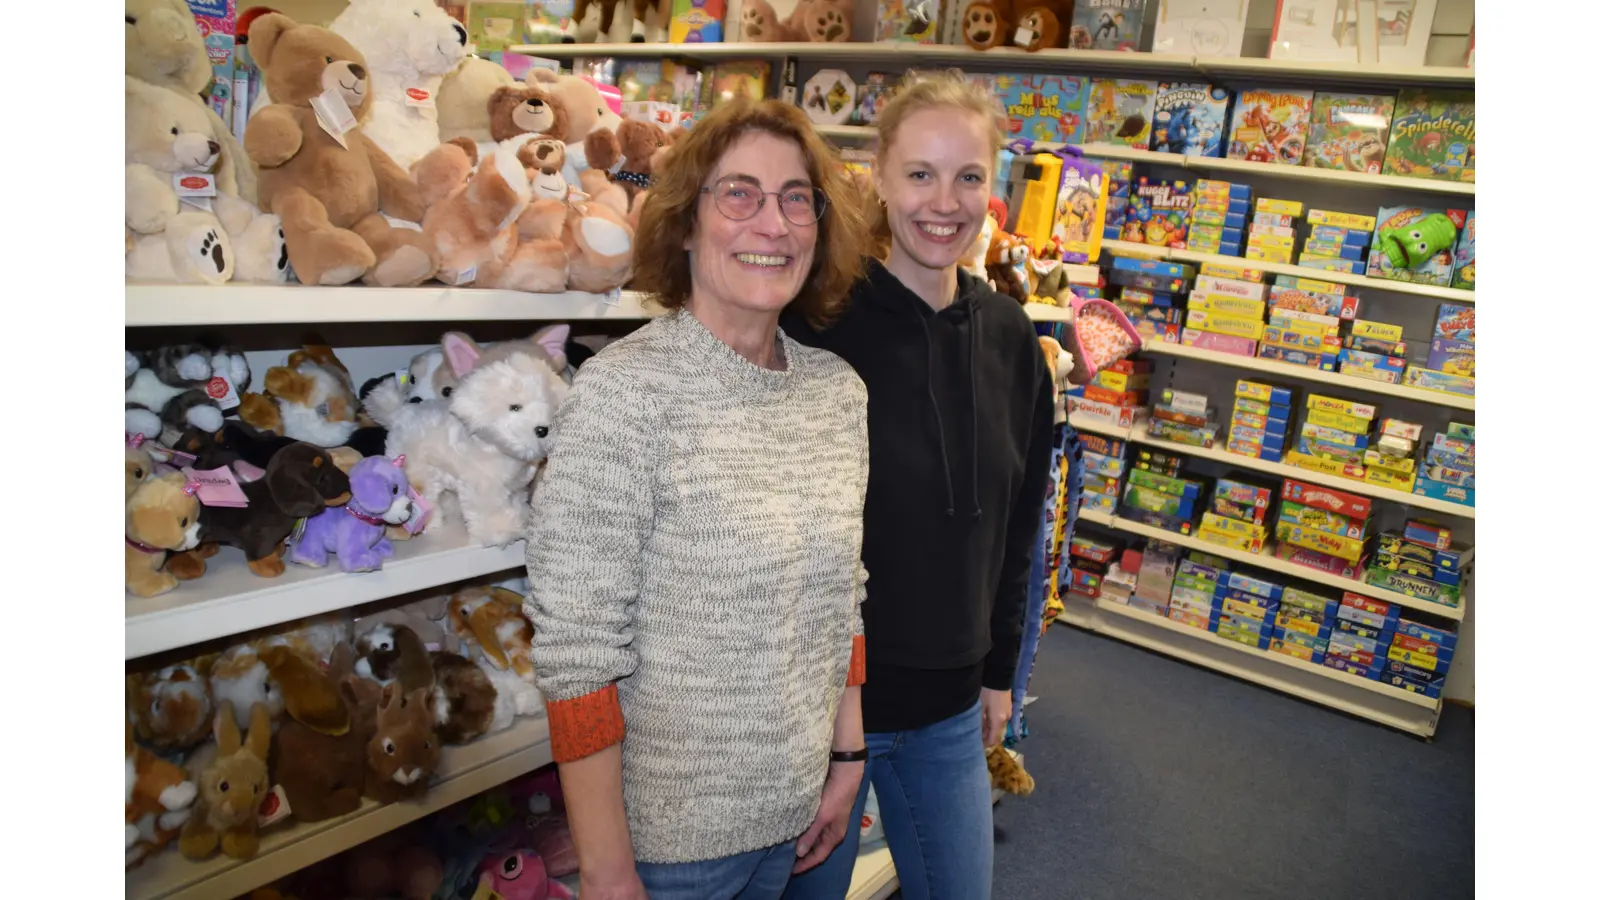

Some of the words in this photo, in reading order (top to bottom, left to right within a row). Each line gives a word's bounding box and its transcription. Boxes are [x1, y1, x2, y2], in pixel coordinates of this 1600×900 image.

[1157, 90, 1205, 107] PINGUIN
[1394, 114, 1475, 141] Spinderell
[1153, 187, 1190, 208] BLITZ
[1079, 402, 1112, 417] Qwirkle
[1319, 462, 1336, 471] Post
[1389, 576, 1437, 596] BRUNNEN
